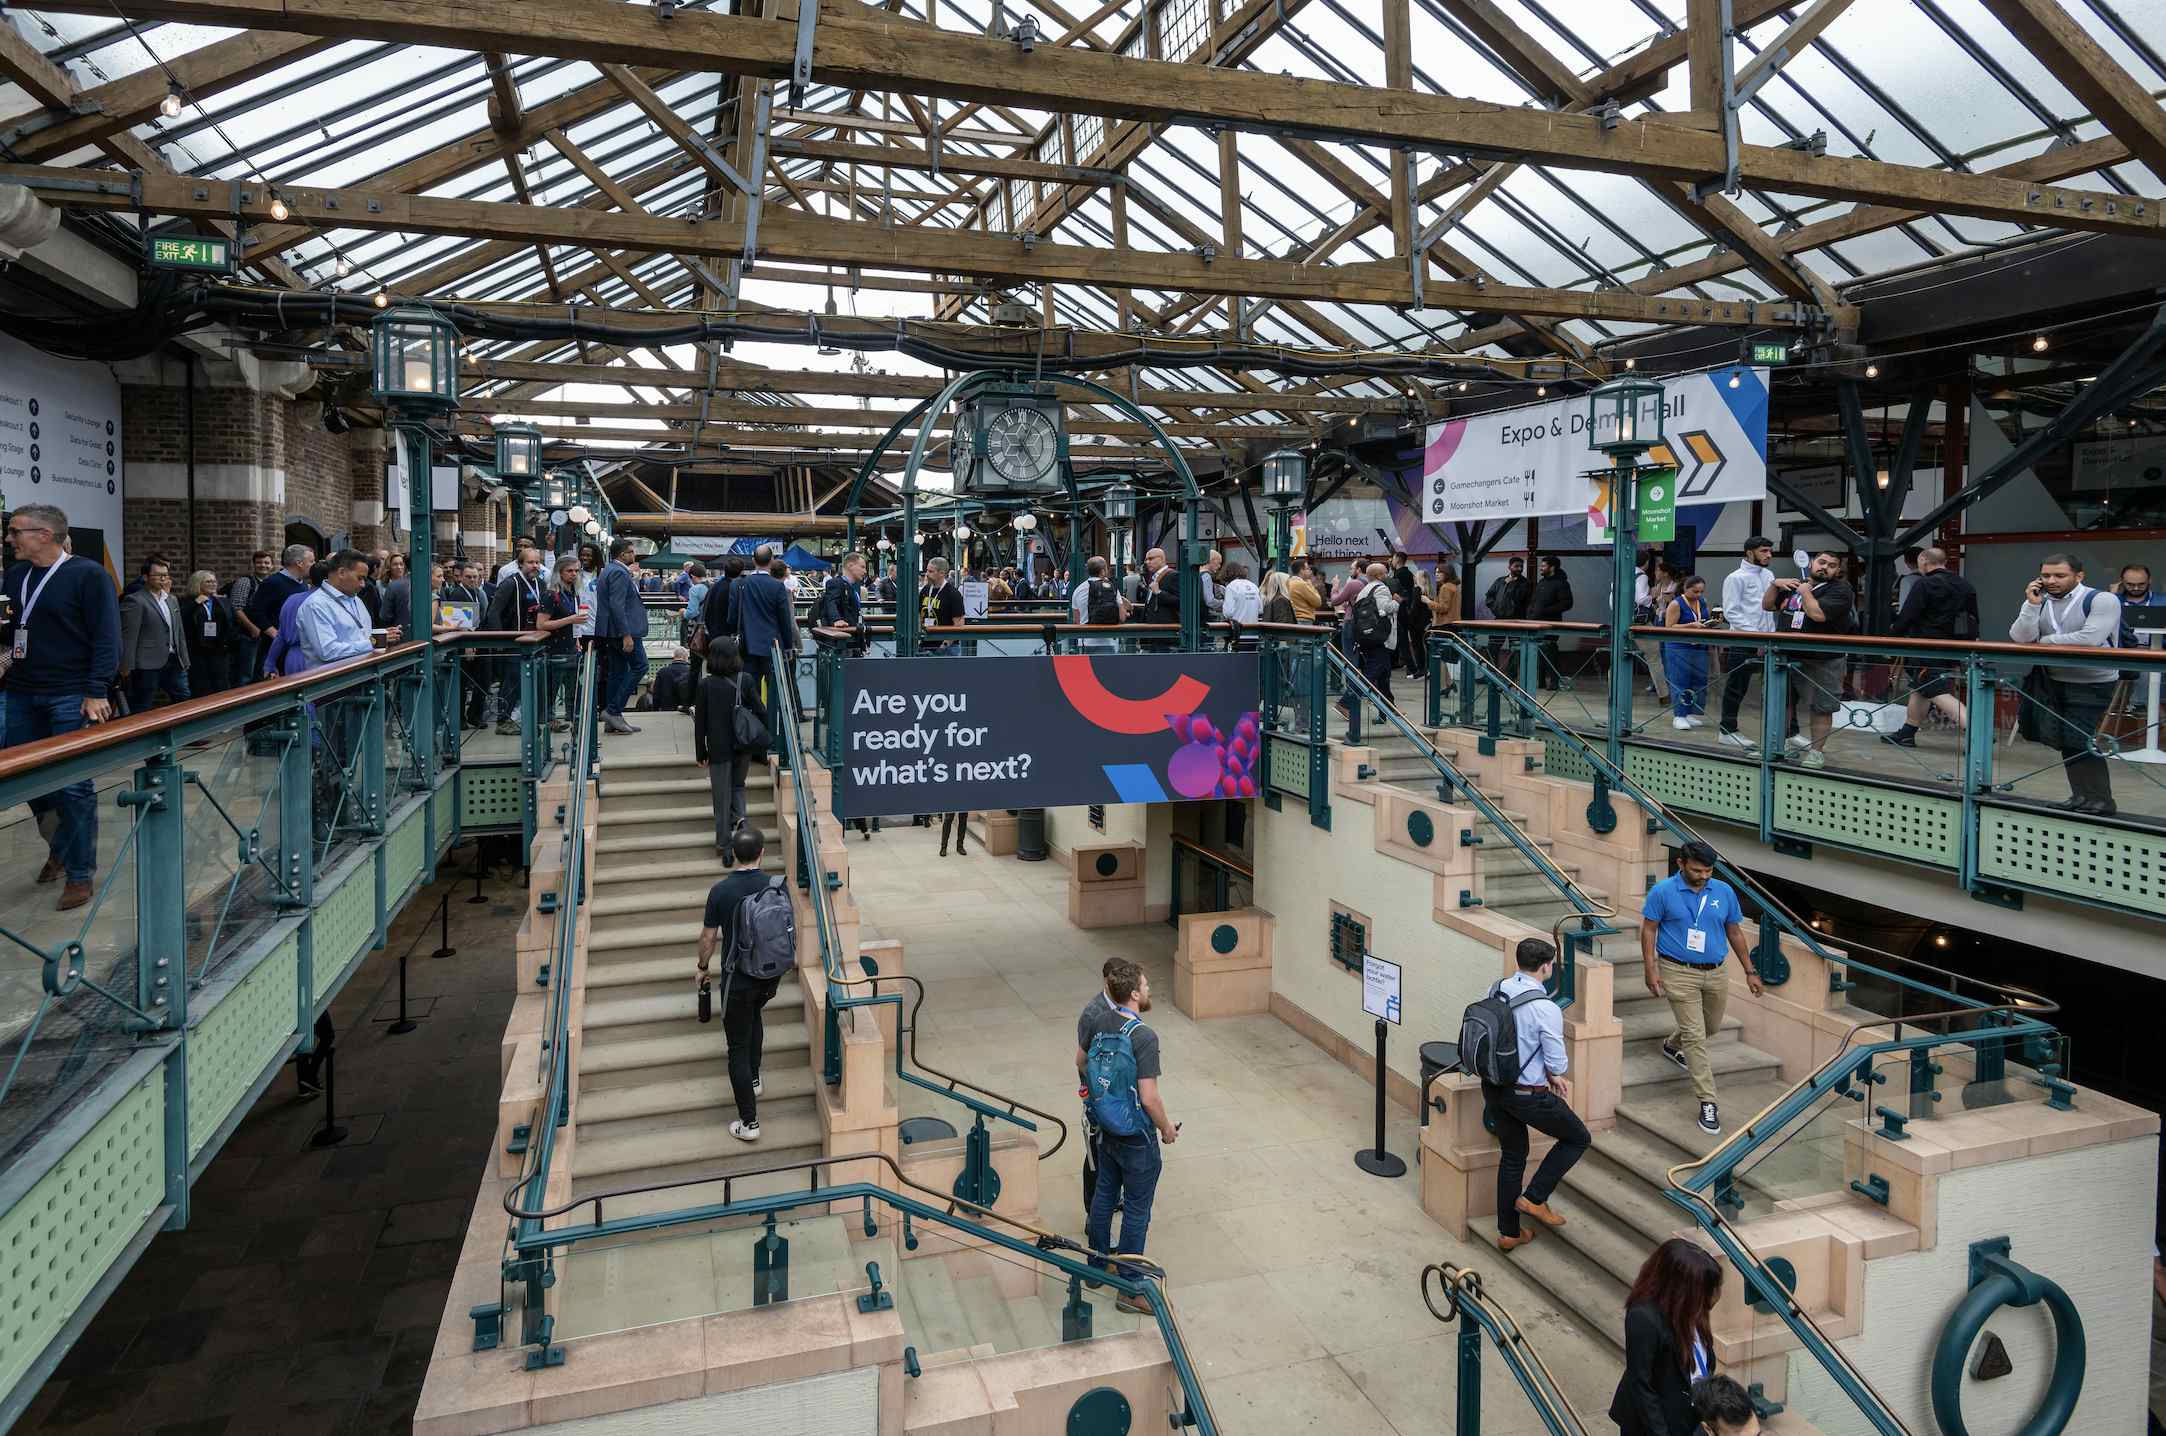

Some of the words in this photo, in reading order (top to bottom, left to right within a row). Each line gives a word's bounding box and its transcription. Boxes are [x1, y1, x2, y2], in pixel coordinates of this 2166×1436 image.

[155, 241, 180, 252] FIRE
[155, 251, 179, 260] EXIT
[1501, 424, 1546, 447] Expo
[1550, 415, 1562, 437] &
[1450, 479, 1501, 490] Gamechangers
[1450, 500, 1483, 511] Moonshot
[1485, 499, 1509, 508] Market
[1316, 534, 1343, 546] Hello
[1345, 536, 1369, 546] next
[852, 688, 906, 714] Are
[913, 693, 967, 720] you
[853, 723, 939, 754] ready
[945, 722, 988, 747] for
[852, 757, 949, 785] what’s
[956, 753, 1032, 781] next?
